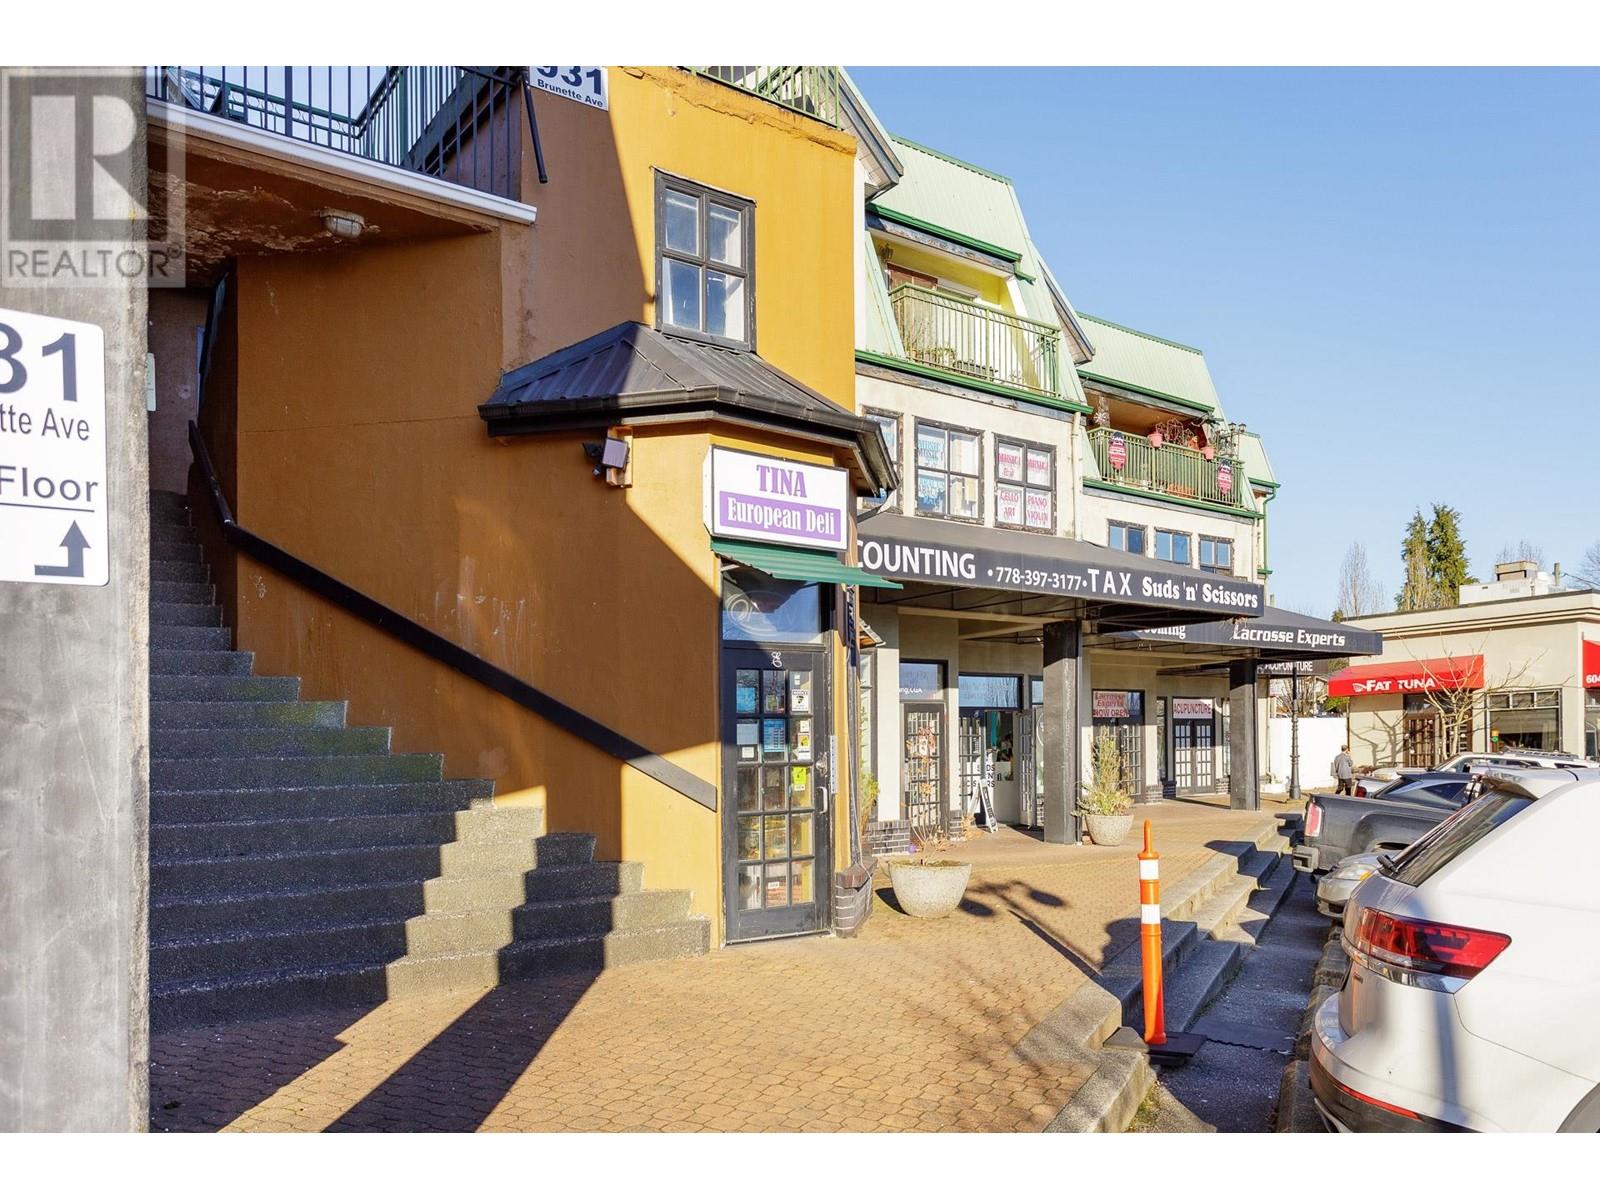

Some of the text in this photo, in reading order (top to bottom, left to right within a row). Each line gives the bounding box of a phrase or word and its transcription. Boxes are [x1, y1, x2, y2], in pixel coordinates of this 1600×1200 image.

[537, 79, 603, 107] Brunette Ave
[41, 408, 90, 441] Ave
[0, 465, 98, 502] Floor
[756, 464, 807, 498] TINA
[727, 497, 835, 535] European Deli
[996, 566, 1082, 591] 778-397-3177
[1088, 569, 1132, 596] TAX
[1142, 577, 1180, 600] Suds
[1202, 583, 1258, 608] Scissors
[1233, 625, 1346, 647] Lacrosse Experts
[1366, 677, 1436, 692] FAT TUNA
[1173, 703, 1213, 715] ACUPUNCTURE
